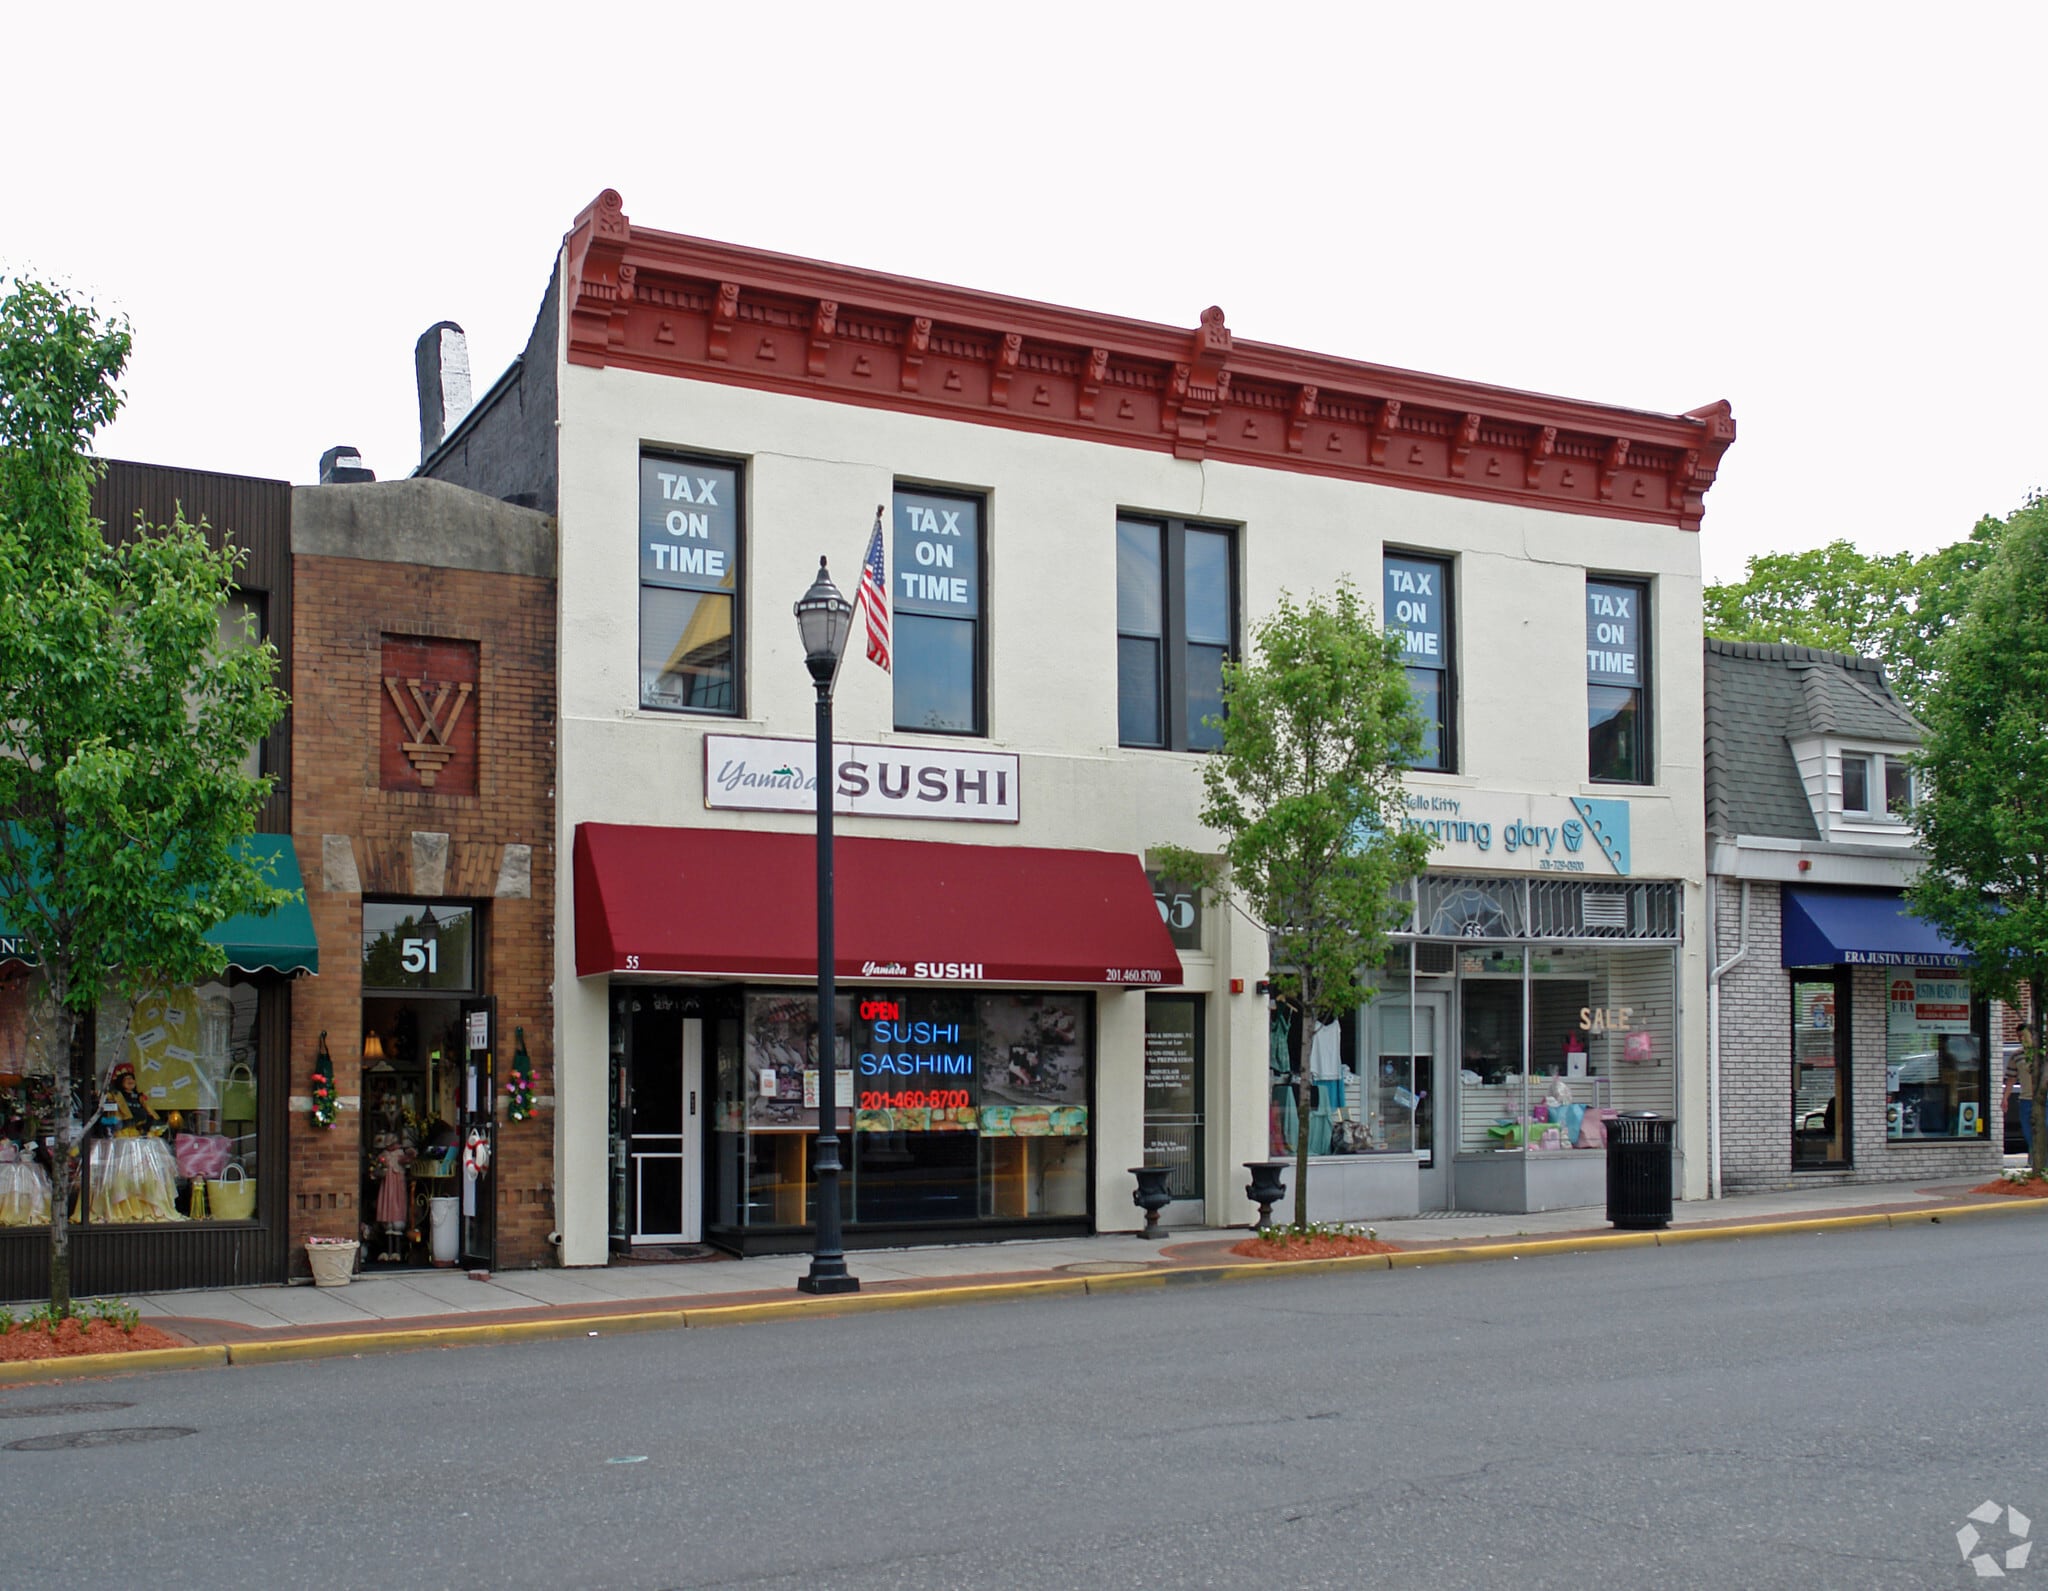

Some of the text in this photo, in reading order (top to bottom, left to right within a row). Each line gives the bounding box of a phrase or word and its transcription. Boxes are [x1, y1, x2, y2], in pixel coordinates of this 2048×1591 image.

[657, 472, 718, 506] TAX
[666, 510, 708, 539] ON
[906, 506, 961, 536] TAX
[650, 543, 724, 577] TIME
[915, 541, 953, 568] ON
[901, 572, 968, 604] TIME
[1389, 569, 1432, 596] TAX
[1396, 600, 1427, 624] ON
[1590, 594, 1630, 618] TAX
[1597, 622, 1624, 645] ON
[1587, 650, 1635, 675] TIME
[717, 760, 1008, 806] Yamada SUSHI
[1432, 796, 1460, 816] Kitty
[1401, 817, 1558, 854] morning glory
[401, 938, 437, 974] 51
[626, 955, 639, 969] 55
[1844, 950, 1866, 963] ERA
[1867, 952, 1901, 965] JUSTIN
[1904, 953, 1940, 967] REALTY
[861, 961, 983, 979] Yamada SUSHI
[1105, 968, 1161, 983] 201.460.8700
[860, 1001, 899, 1020] OPEN
[1579, 1007, 1631, 1031] SALE
[1892, 1002, 1914, 1013] ERA
[874, 1021, 959, 1044] SUSHI
[860, 1053, 972, 1076] SASHIMI
[861, 1089, 969, 1111] 201-460-8700
